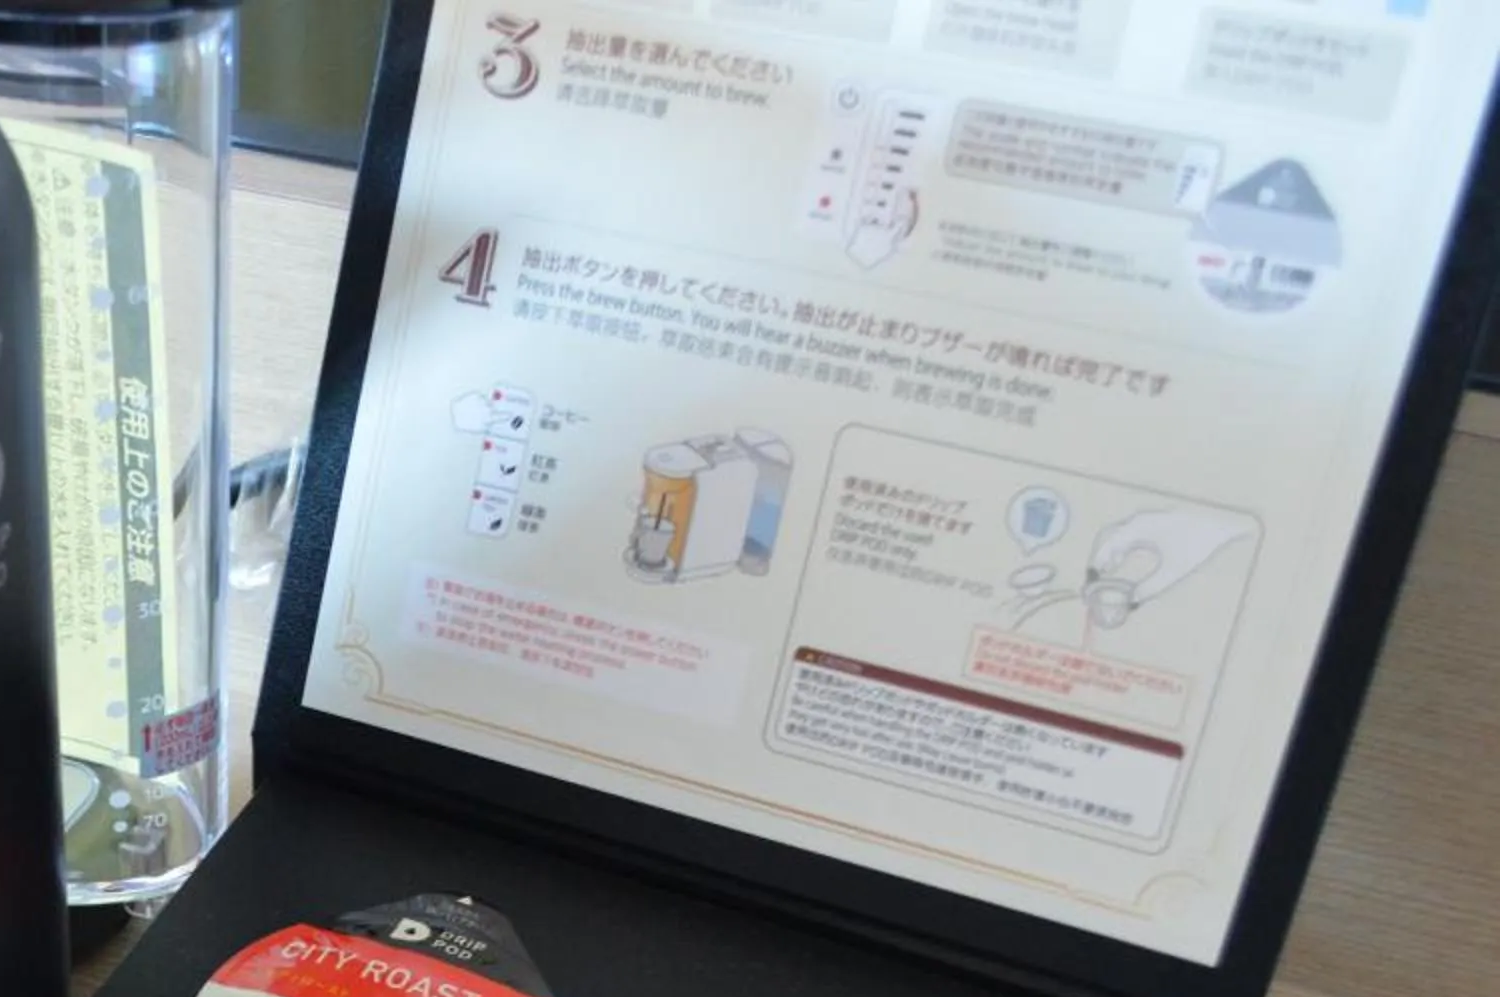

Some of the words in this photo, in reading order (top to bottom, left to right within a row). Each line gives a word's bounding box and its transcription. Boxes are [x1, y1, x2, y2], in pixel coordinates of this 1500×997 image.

[479, 13, 540, 99] 3
[561, 58, 606, 80] Select
[611, 62, 637, 82] the
[639, 70, 700, 96] amount
[705, 79, 722, 97] to
[439, 228, 498, 307] 4
[517, 273, 555, 298] Press
[559, 279, 584, 300] the
[587, 284, 625, 310] brew
[629, 294, 685, 324] button.
[690, 306, 721, 332] You
[724, 313, 752, 337] will
[754, 319, 789, 345] hear
[807, 333, 862, 362] buzzer
[865, 346, 911, 371] when
[915, 356, 985, 390] brewing
[988, 373, 1001, 391] is
[119, 375, 155, 586] 使用上のご注意
[281, 940, 358, 970] CITY
[431, 939, 472, 960] POD
[440, 931, 487, 951] DRIP
